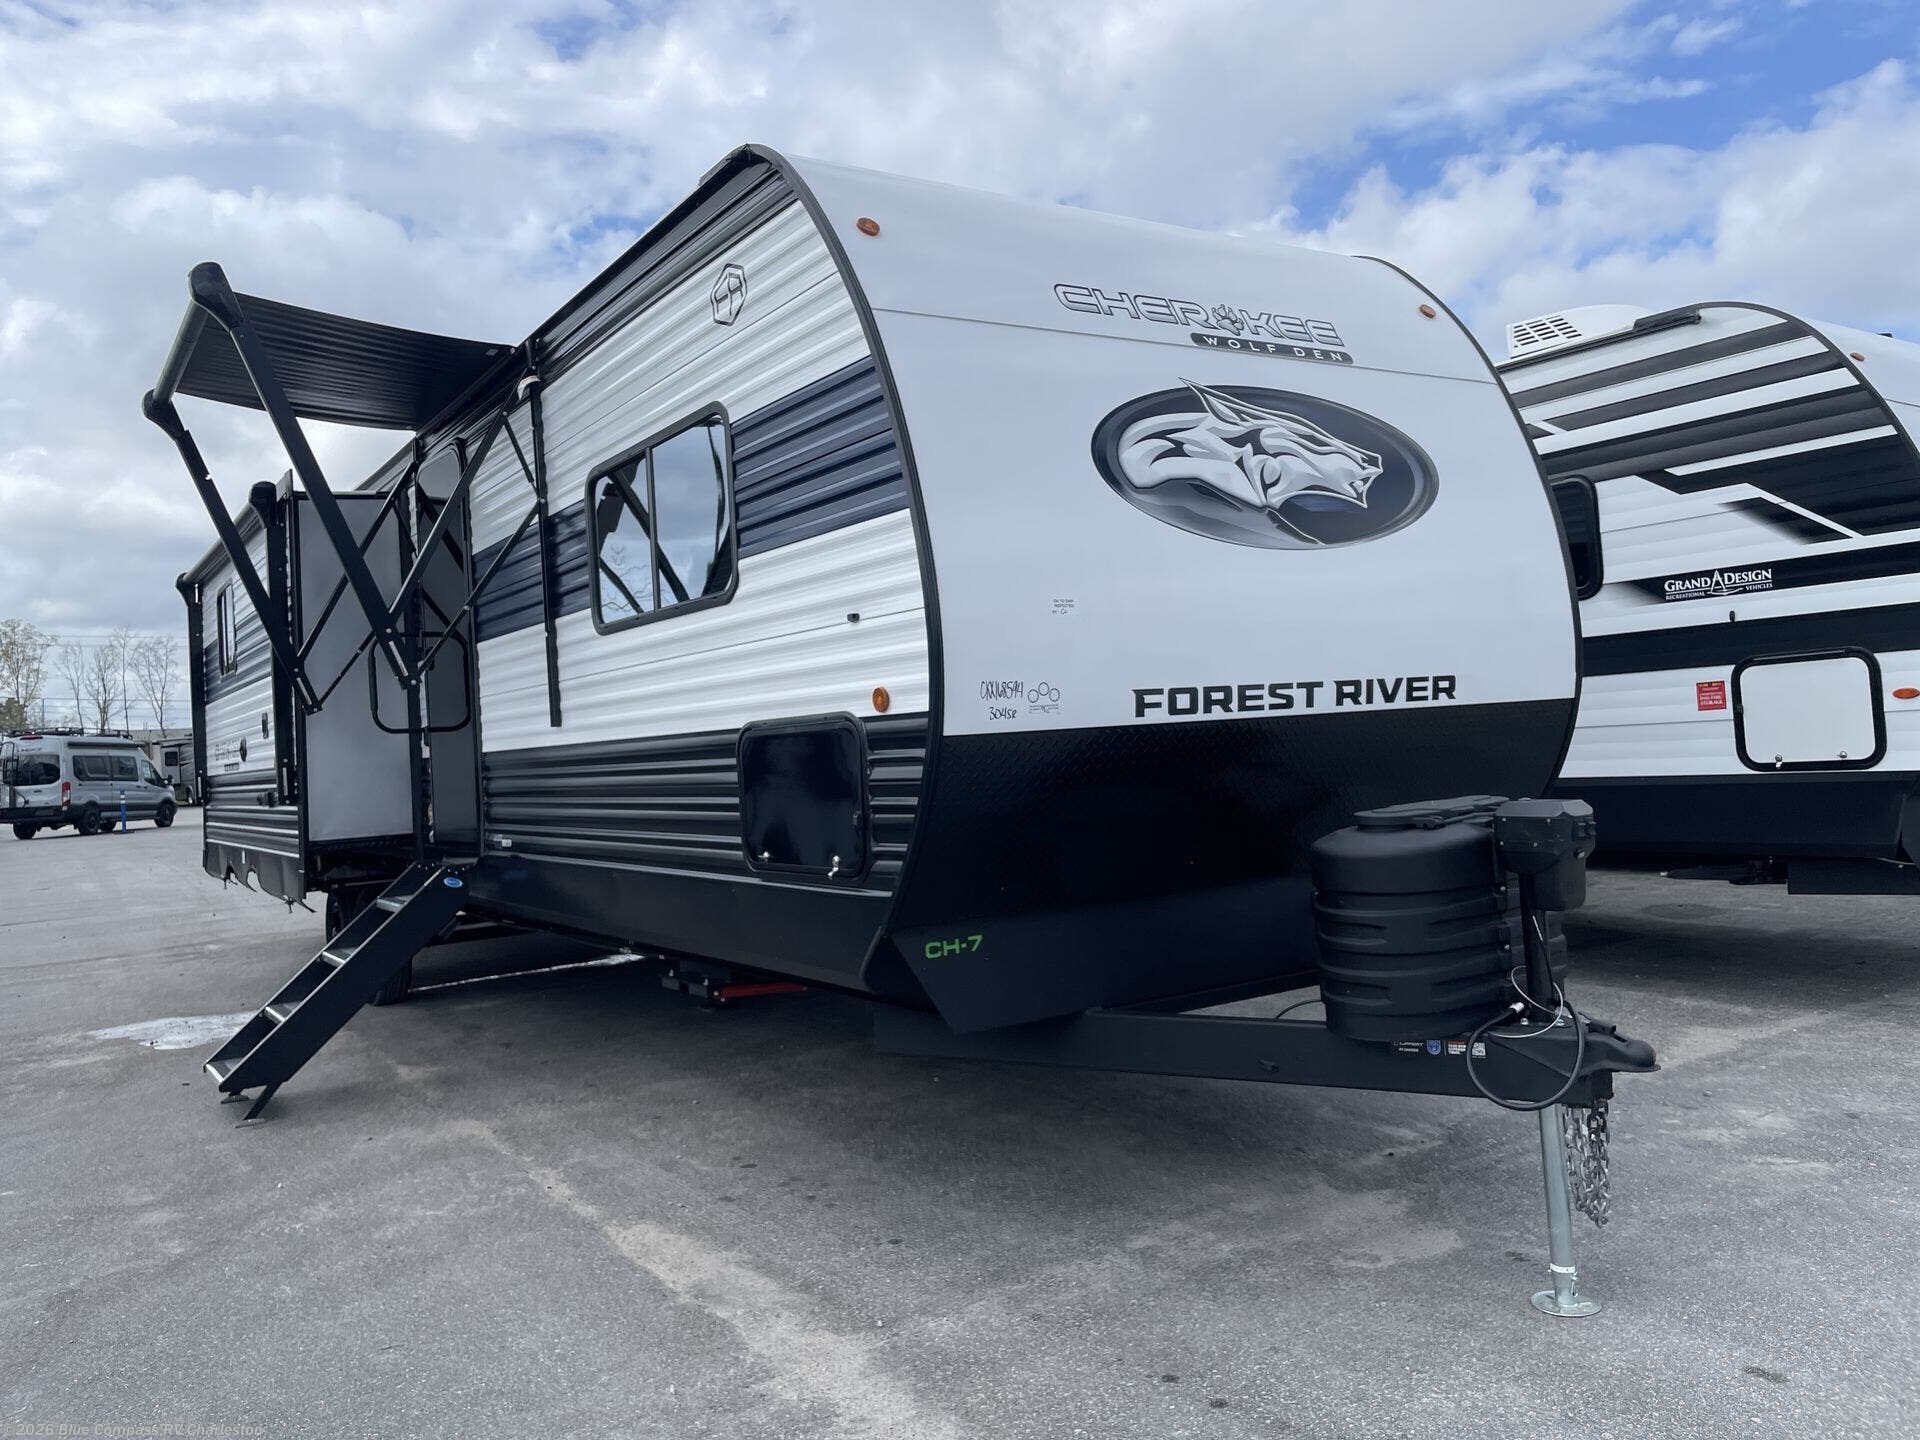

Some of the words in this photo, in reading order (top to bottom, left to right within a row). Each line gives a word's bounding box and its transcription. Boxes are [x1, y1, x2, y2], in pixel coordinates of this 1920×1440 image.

[1203, 335, 1277, 354] WOLF
[1292, 346, 1343, 362] DEN
[1664, 576, 1711, 592] GRAND
[1724, 568, 1773, 585] DESIGN
[1665, 591, 1706, 601] RECREATIONAL
[1745, 582, 1773, 591] VEHICLES
[1131, 680, 1324, 718] FOREST
[1333, 674, 1457, 706] RIVER
[924, 934, 984, 959] CH-7
